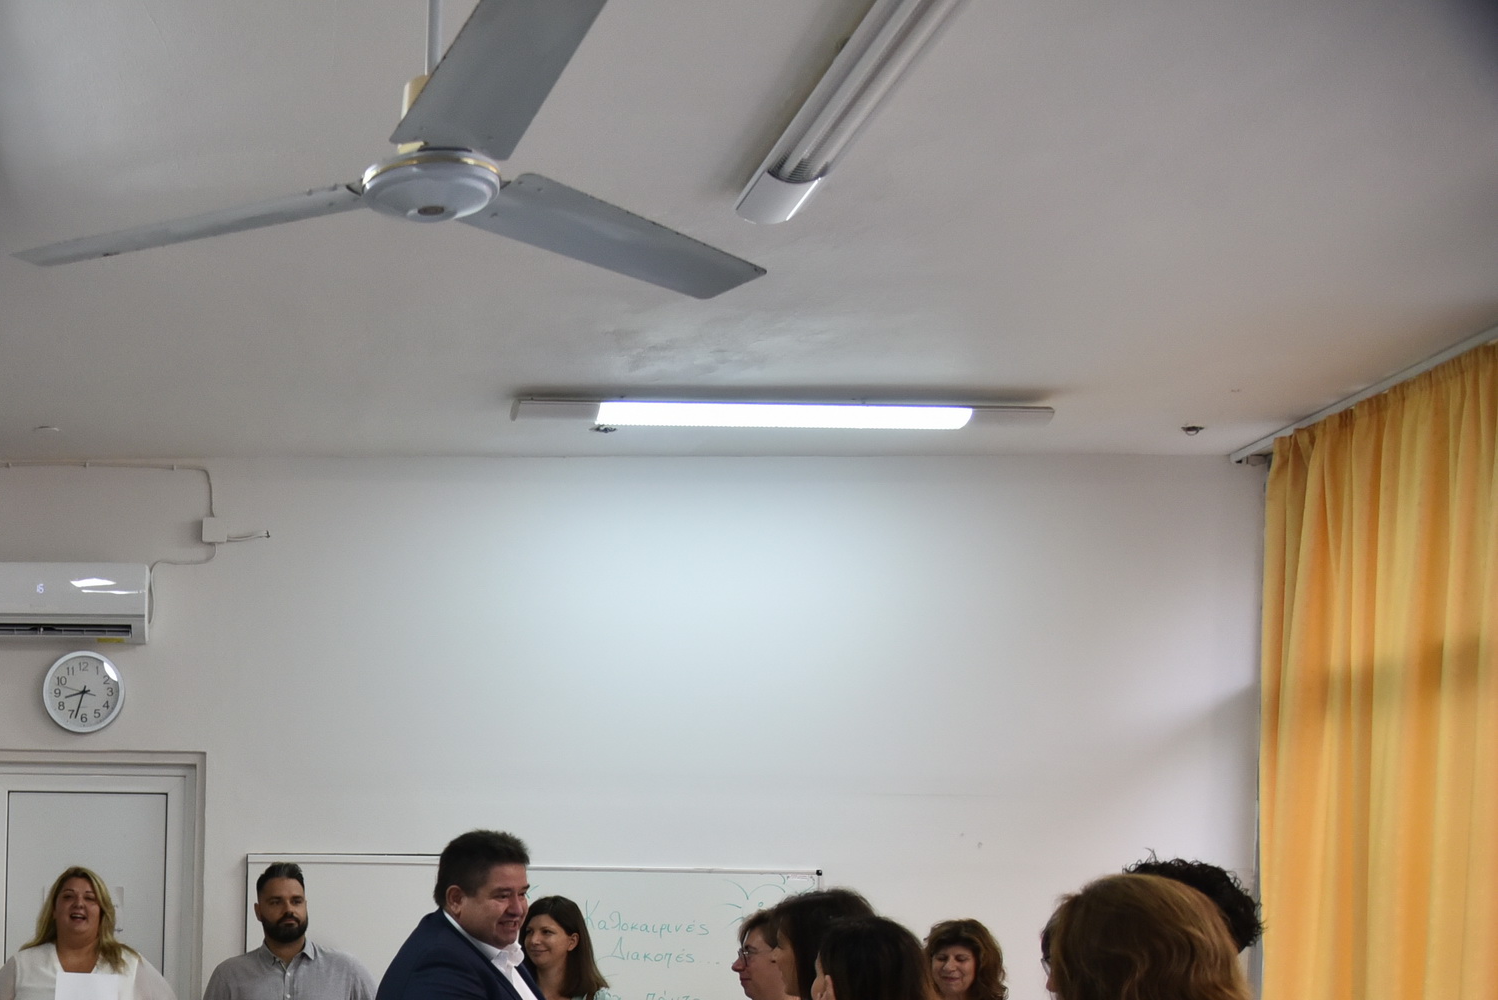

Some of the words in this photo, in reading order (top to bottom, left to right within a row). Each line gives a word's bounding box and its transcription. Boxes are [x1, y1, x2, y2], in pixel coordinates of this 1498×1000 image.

[66, 666, 74, 676] 11
[78, 662, 88, 672] 12
[96, 666, 99, 675] 1
[56, 676, 67, 686] 10
[103, 676, 110, 684] 2
[54, 688, 62, 698] 9
[106, 688, 114, 696] 3
[58, 701, 65, 710] 8
[102, 700, 110, 710] 4
[68, 710, 75, 719] 7
[80, 714, 88, 722] 6
[94, 709, 100, 718] 5
[585, 899, 710, 938] Καλοκαιρινές
